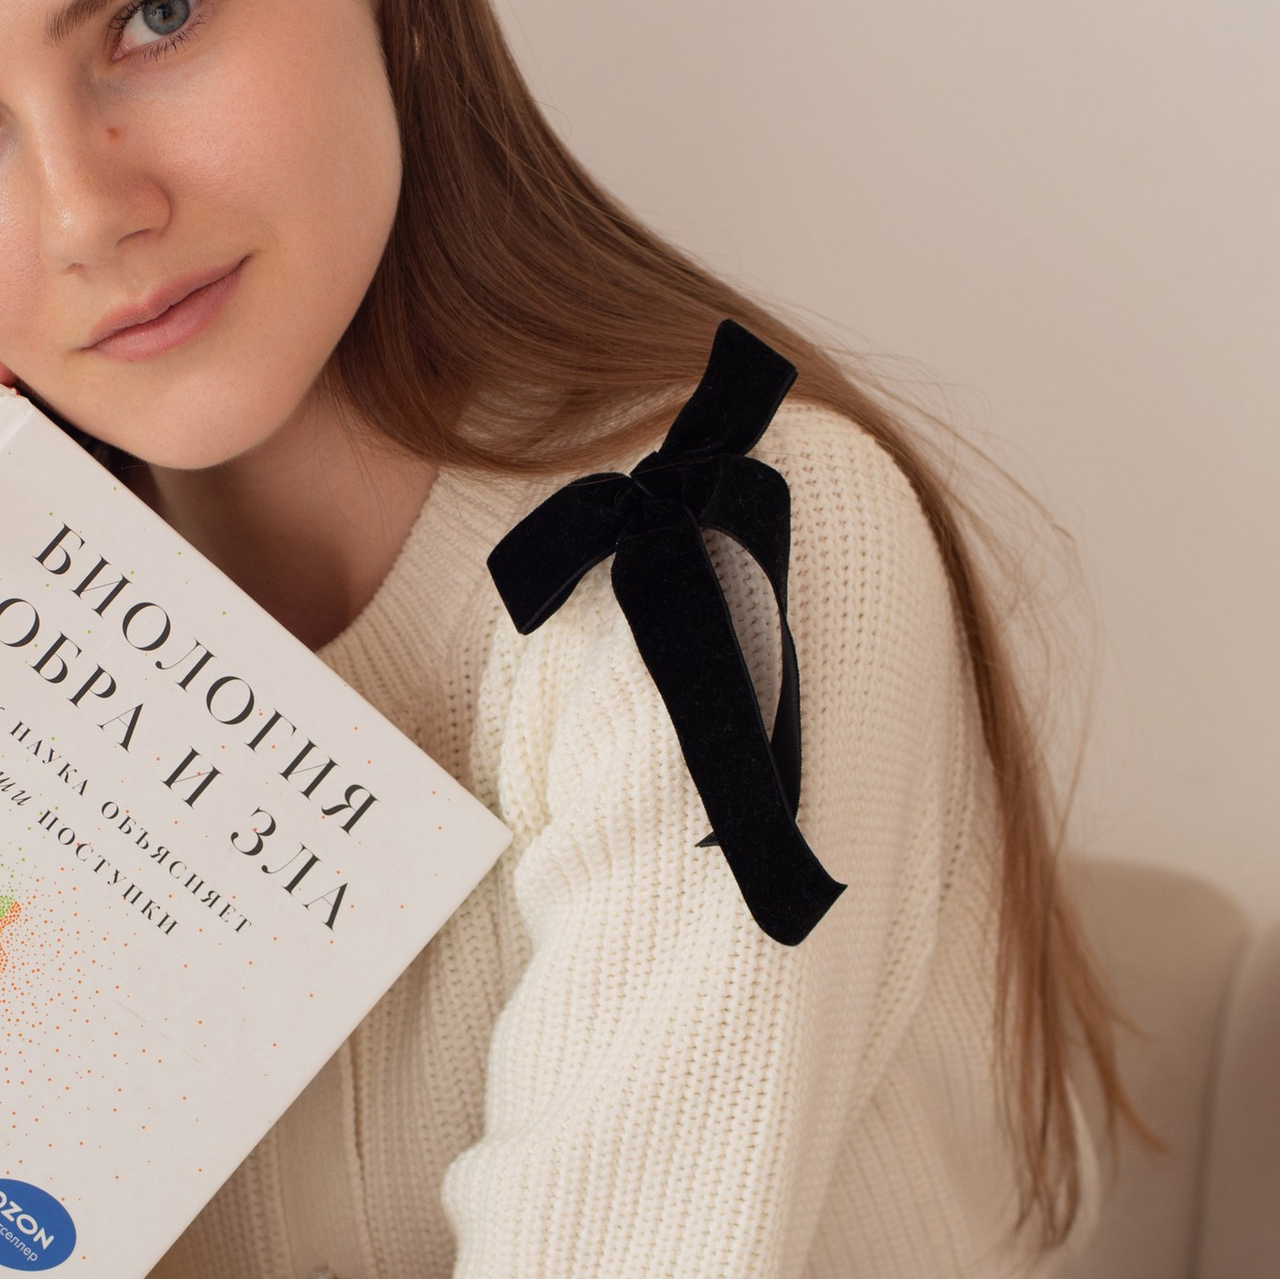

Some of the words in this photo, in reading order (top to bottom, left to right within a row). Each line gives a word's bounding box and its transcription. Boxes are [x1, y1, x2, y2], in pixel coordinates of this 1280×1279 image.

[33, 523, 379, 835] БИОЛОГИЯ
[9, 720, 90, 797] НАУКА
[101, 800, 253, 933] ОБЪЯСНЯЕТ
[37, 809, 179, 936] ПОСТУПКИ
[161, 746, 223, 809] И
[230, 807, 353, 931] ЗЛА
